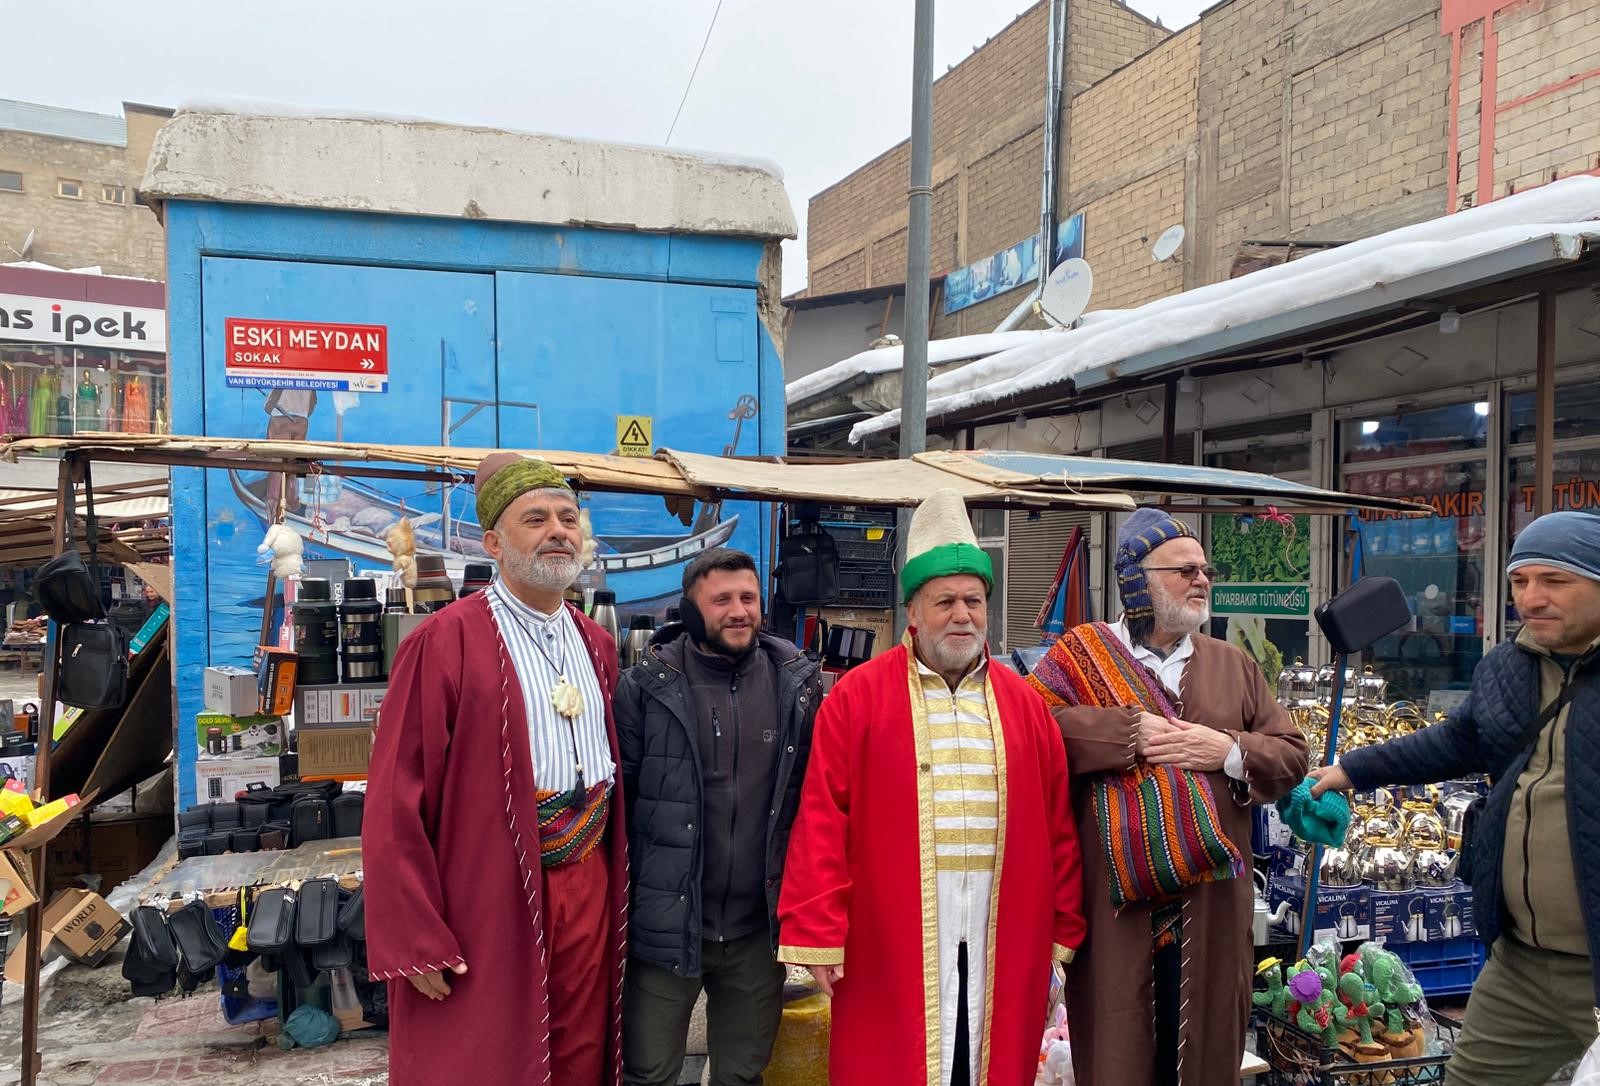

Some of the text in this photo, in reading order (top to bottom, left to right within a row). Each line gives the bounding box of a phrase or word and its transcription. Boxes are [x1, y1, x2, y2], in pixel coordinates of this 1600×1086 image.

[51, 304, 146, 341] ipek
[232, 326, 380, 352] ESKİ MEYDAN
[234, 352, 281, 364] SOKAK
[228, 377, 338, 389] VAN BÜYÜKŞEHİR BELEDİYESİ
[1521, 477, 1600, 512] TTÜN
[1215, 590, 1306, 607] DİYARBAKIR TÜTÜNCÜSÜ
[1273, 883, 1296, 895] VICALINA
[1318, 894, 1347, 903] VICALINA
[1429, 896, 1454, 904] VICALINA
[63, 903, 97, 934] WORLD
